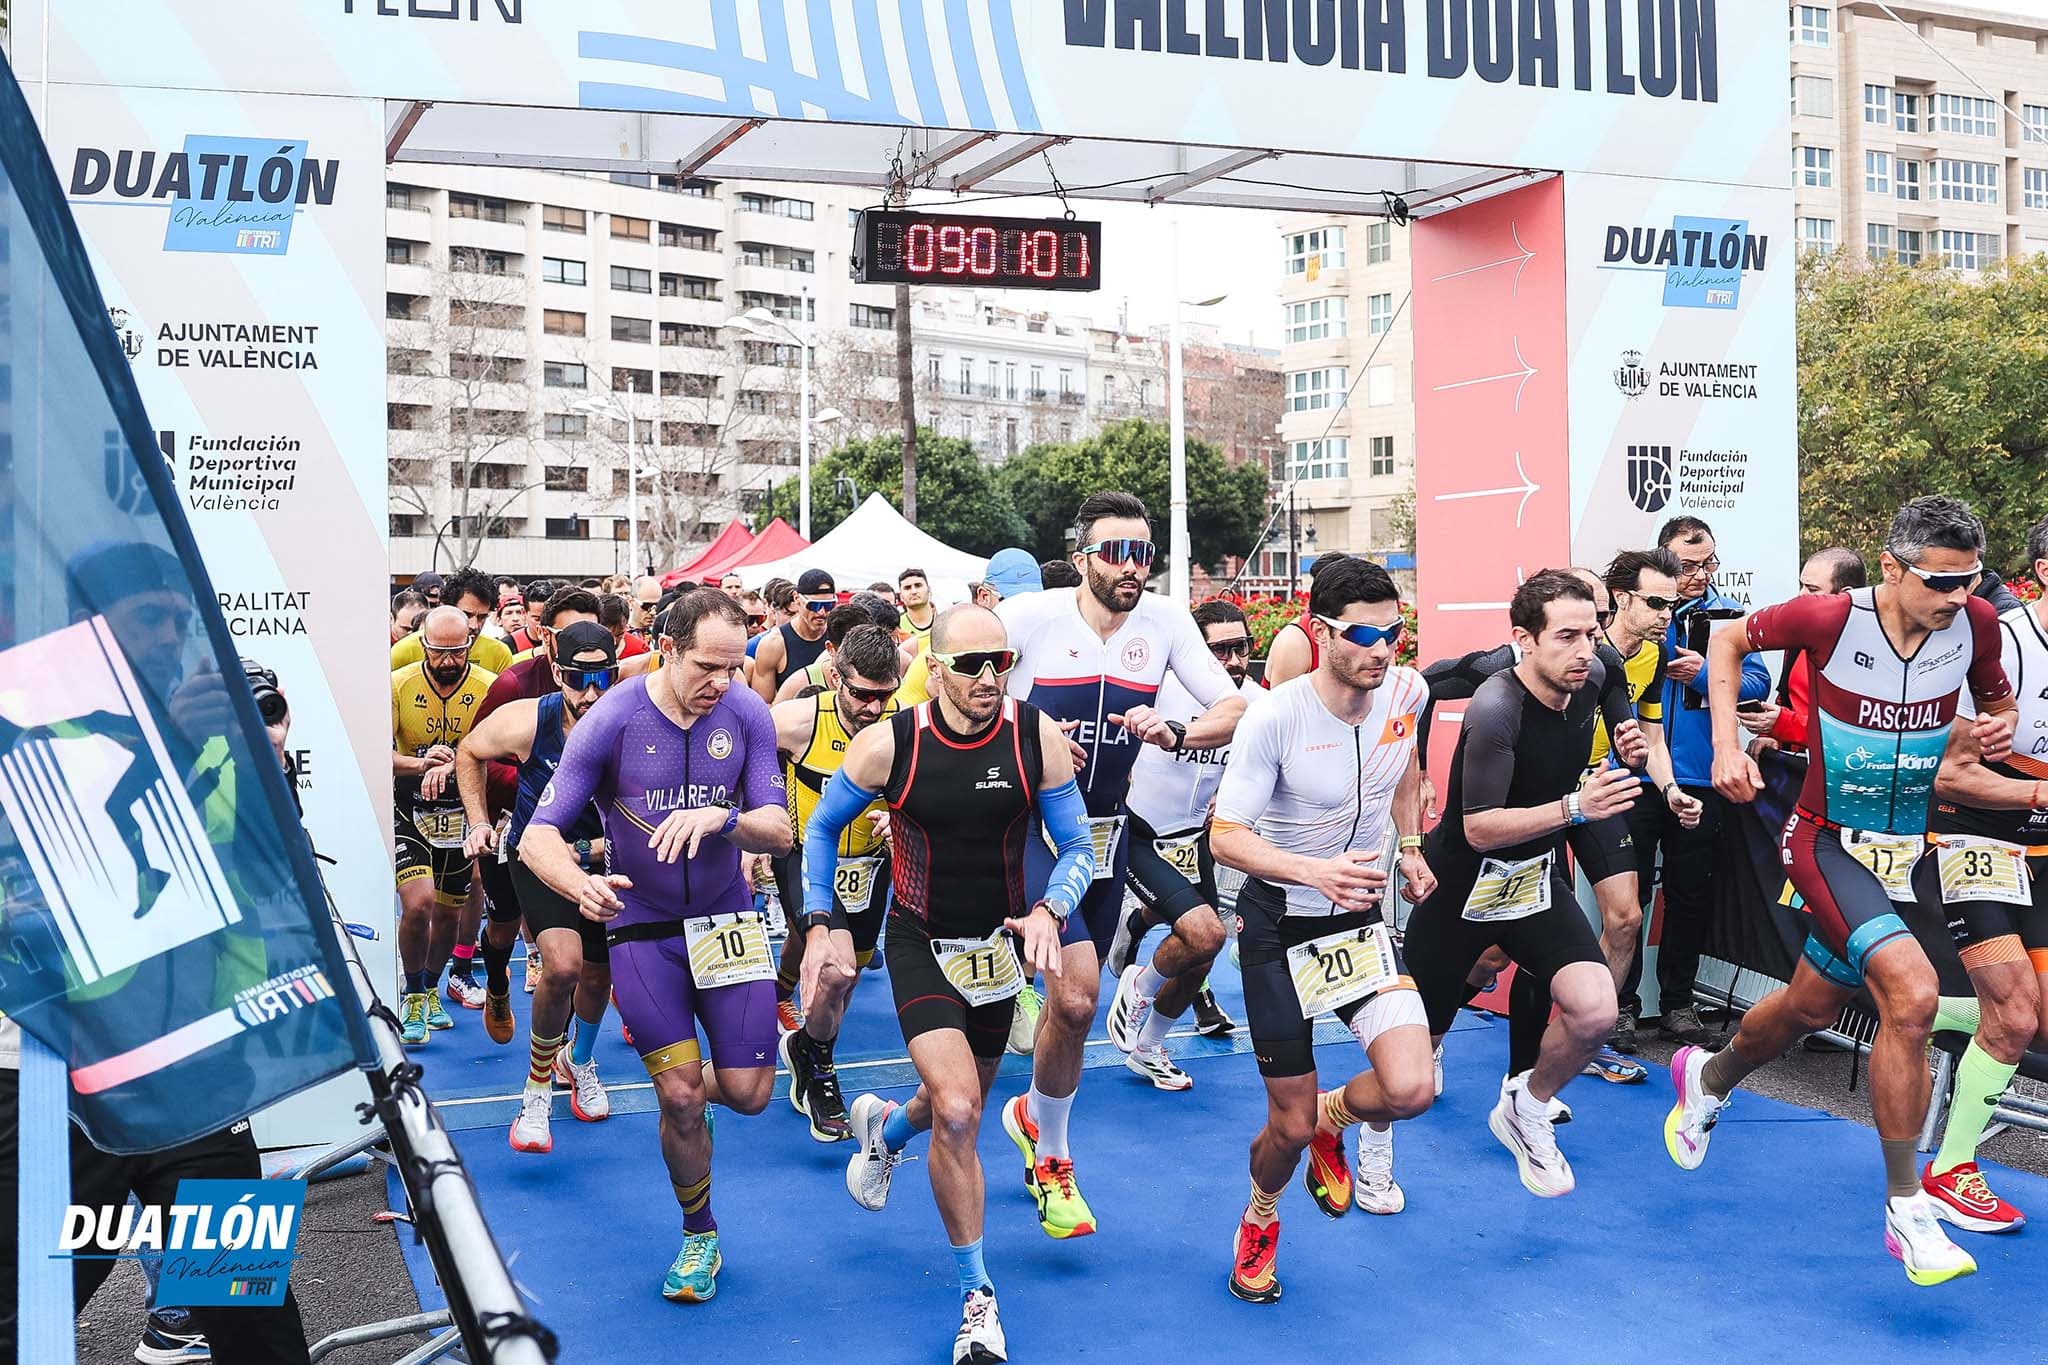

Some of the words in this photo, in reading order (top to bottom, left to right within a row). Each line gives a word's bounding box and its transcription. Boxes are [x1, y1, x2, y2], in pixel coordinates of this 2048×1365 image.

[69, 145, 340, 206] DUATLÓN
[174, 200, 291, 227] València
[1604, 224, 1768, 271] DUATLÓN
[157, 322, 319, 344] AJUNTAMENT
[157, 348, 190, 367] DE
[198, 345, 318, 370] VALÈNCIA
[1659, 362, 1757, 379] AJUNTAMENT
[1659, 382, 1680, 397] DE
[1684, 380, 1757, 399] VALÈNCIA
[189, 435, 301, 452] Fundación
[189, 455, 297, 475] Deportiva
[1679, 450, 1748, 463] Fundación
[1679, 465, 1745, 480] Deportiva
[189, 475, 296, 494] Municipal
[1679, 481, 1744, 496] Municipal
[189, 494, 280, 510] València
[1680, 496, 1735, 509] València
[1709, 572, 1754, 587] ALITAT
[218, 591, 311, 611] RALITAT
[1858, 699, 1942, 730] PASCUAL
[426, 717, 462, 733] SANZ
[1866, 762, 1897, 770] Frutas
[975, 781, 1012, 789] SURAL
[646, 784, 727, 811] VILLAREJO
[432, 814, 449, 833] 19
[1175, 847, 1195, 868] 22
[1870, 847, 1893, 875] 17
[1964, 850, 1993, 878] 33
[837, 869, 860, 893] 28
[1497, 875, 1525, 900] 47
[716, 930, 746, 960] 10
[966, 953, 995, 980] 11
[1320, 948, 1354, 983] 20
